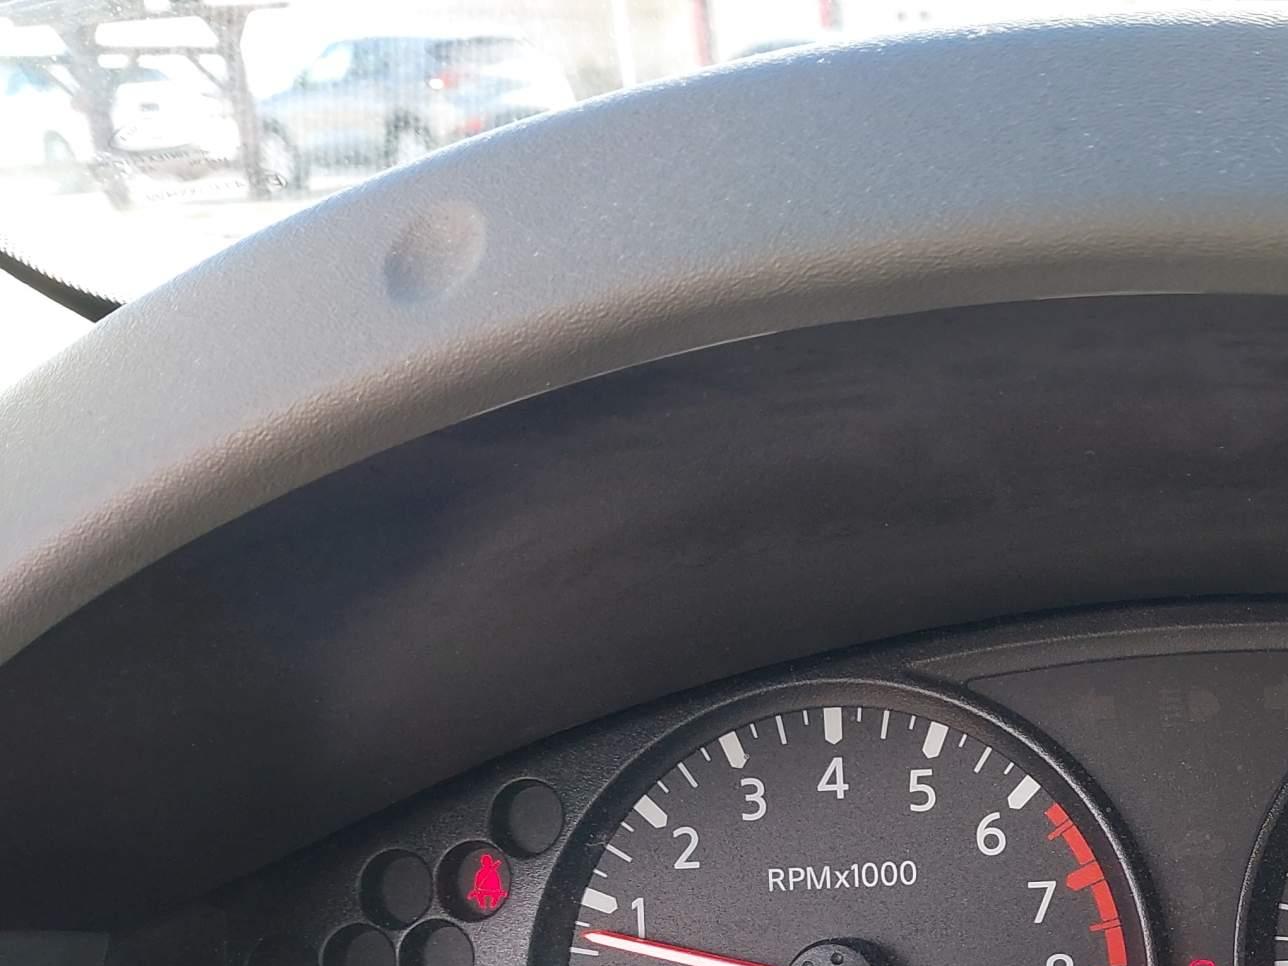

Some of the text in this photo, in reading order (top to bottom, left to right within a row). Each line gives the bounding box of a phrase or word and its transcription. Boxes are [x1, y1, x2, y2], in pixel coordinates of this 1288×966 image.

[740, 777, 767, 821] 3
[817, 757, 849, 799] 4
[909, 768, 936, 812] 5
[672, 826, 700, 870] 2
[976, 811, 1006, 856] 6
[768, 860, 917, 892] RPMx1000
[631, 897, 645, 938] 1
[1027, 880, 1057, 924] 7
